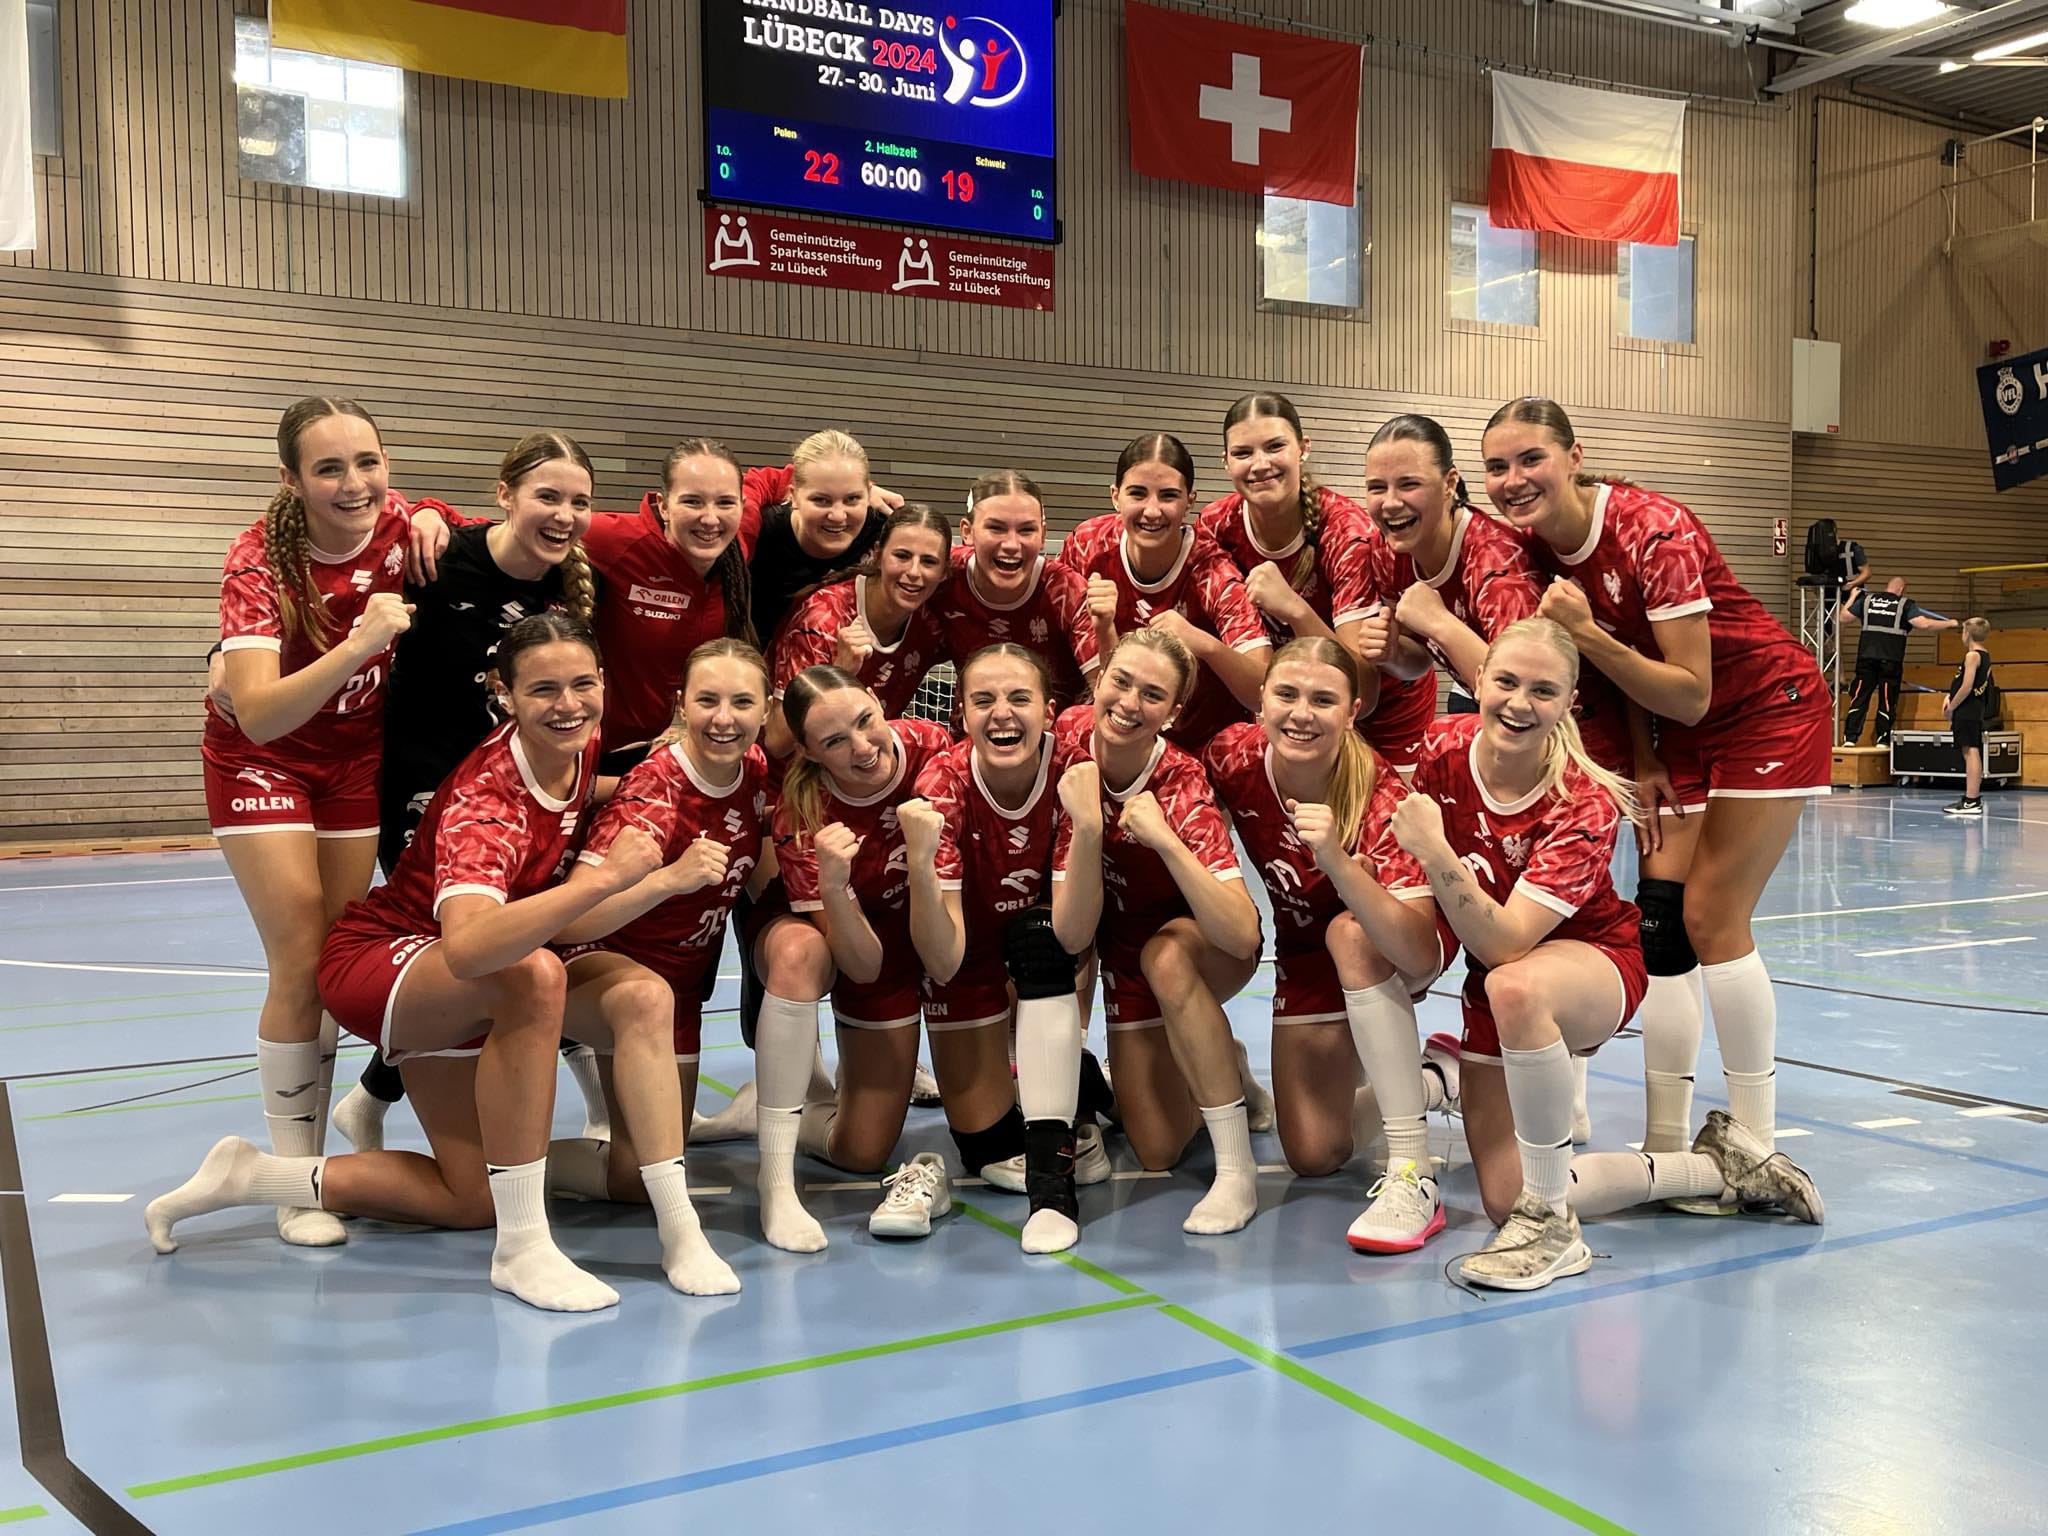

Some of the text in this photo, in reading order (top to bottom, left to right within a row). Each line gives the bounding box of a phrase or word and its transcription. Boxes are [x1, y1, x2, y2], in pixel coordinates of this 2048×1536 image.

[879, 8, 935, 36] DAYS
[743, 13, 937, 74] LÜBECK 2024
[891, 77, 936, 102] Juni
[773, 126, 798, 139] Polen
[865, 140, 918, 159] 2. Halbzeit
[719, 163, 730, 179] 0
[803, 150, 840, 184] 22
[975, 156, 1006, 170] Schweiz
[861, 161, 921, 192] 60:00
[942, 169, 975, 203] 19
[1033, 205, 1042, 221] 0
[770, 228, 857, 251] Gemeinnützige
[770, 244, 883, 271] Sparkassenstiftung
[948, 251, 1028, 272] Gemeinnützige
[770, 261, 828, 277] zu Lübeck
[948, 265, 1051, 290] Sparkassenstiftung
[948, 281, 1001, 296] zu Lübeck
[654, 594, 685, 605] ORLEN
[644, 609, 681, 621] SUZUKI
[231, 796, 295, 812] ORLEN
